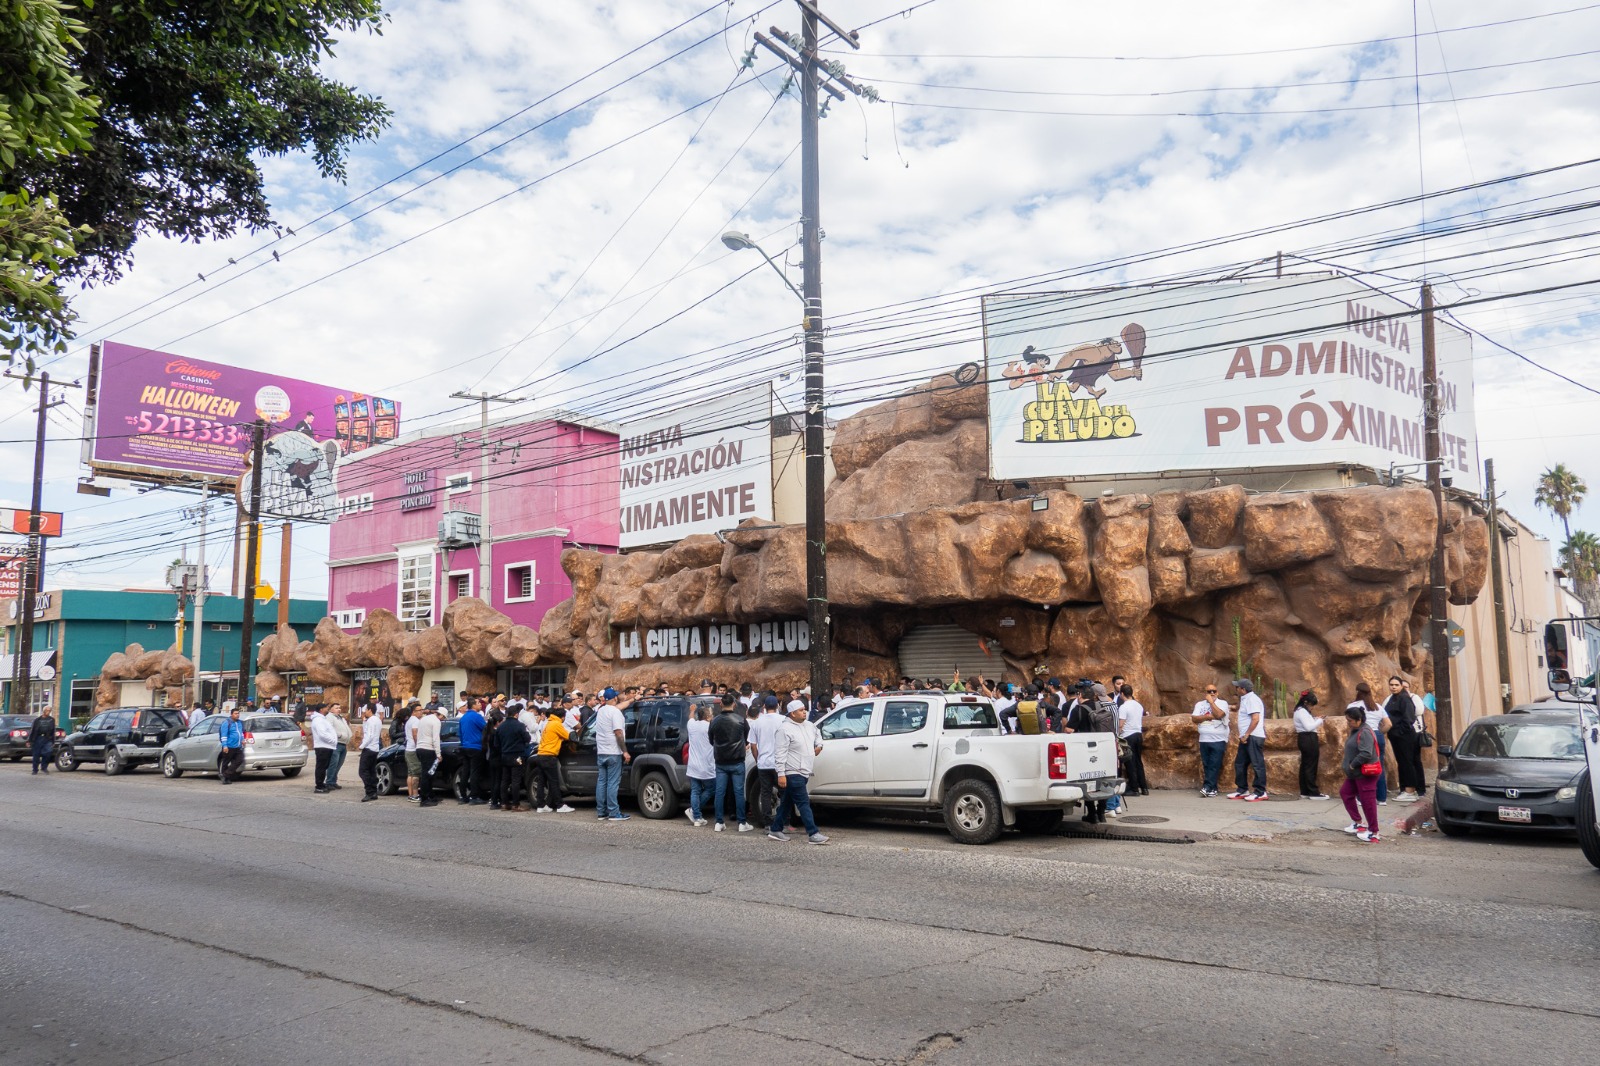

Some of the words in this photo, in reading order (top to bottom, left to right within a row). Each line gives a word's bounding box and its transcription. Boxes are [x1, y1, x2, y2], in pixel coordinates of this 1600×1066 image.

[1346, 299, 1411, 354] NUEVA
[165, 359, 222, 380] Caliente
[180, 374, 209, 385] CASINO
[1224, 340, 1457, 412] ADMINISTRACÓN
[140, 384, 241, 418] HALLOWEEN
[1036, 381, 1072, 401] LA
[1023, 398, 1102, 421] CUEVA
[1101, 404, 1131, 418] DEL
[1023, 414, 1136, 442] PELUDO
[622, 423, 683, 461] NUEVA
[404, 470, 428, 485] HOTEL
[408, 484, 424, 495] DON
[400, 494, 432, 509] PONCHO
[619, 631, 642, 660] LA
[646, 626, 704, 658] CUEVA
[708, 624, 743, 655] DEL
[749, 619, 811, 653] PELUD
